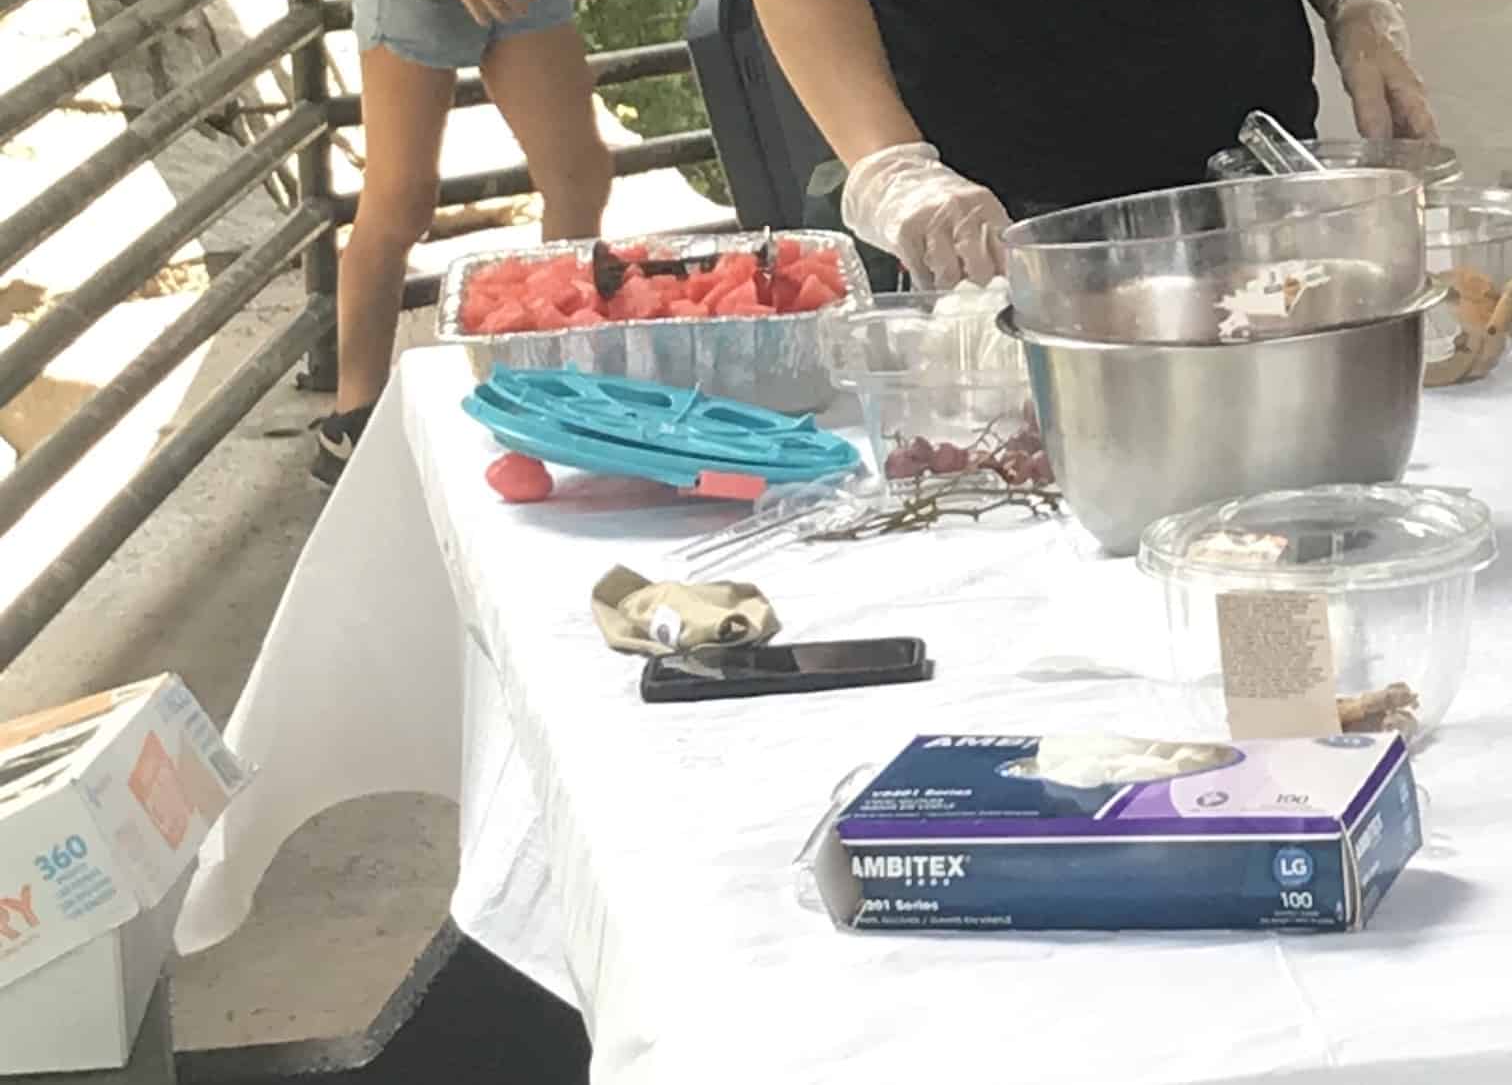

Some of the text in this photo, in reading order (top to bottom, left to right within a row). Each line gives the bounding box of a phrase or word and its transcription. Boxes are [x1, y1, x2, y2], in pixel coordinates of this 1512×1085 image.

[34, 833, 88, 881] 360
[852, 854, 966, 879] AMBITEX
[1279, 858, 1308, 877] LG
[1279, 891, 1313, 909] 100
